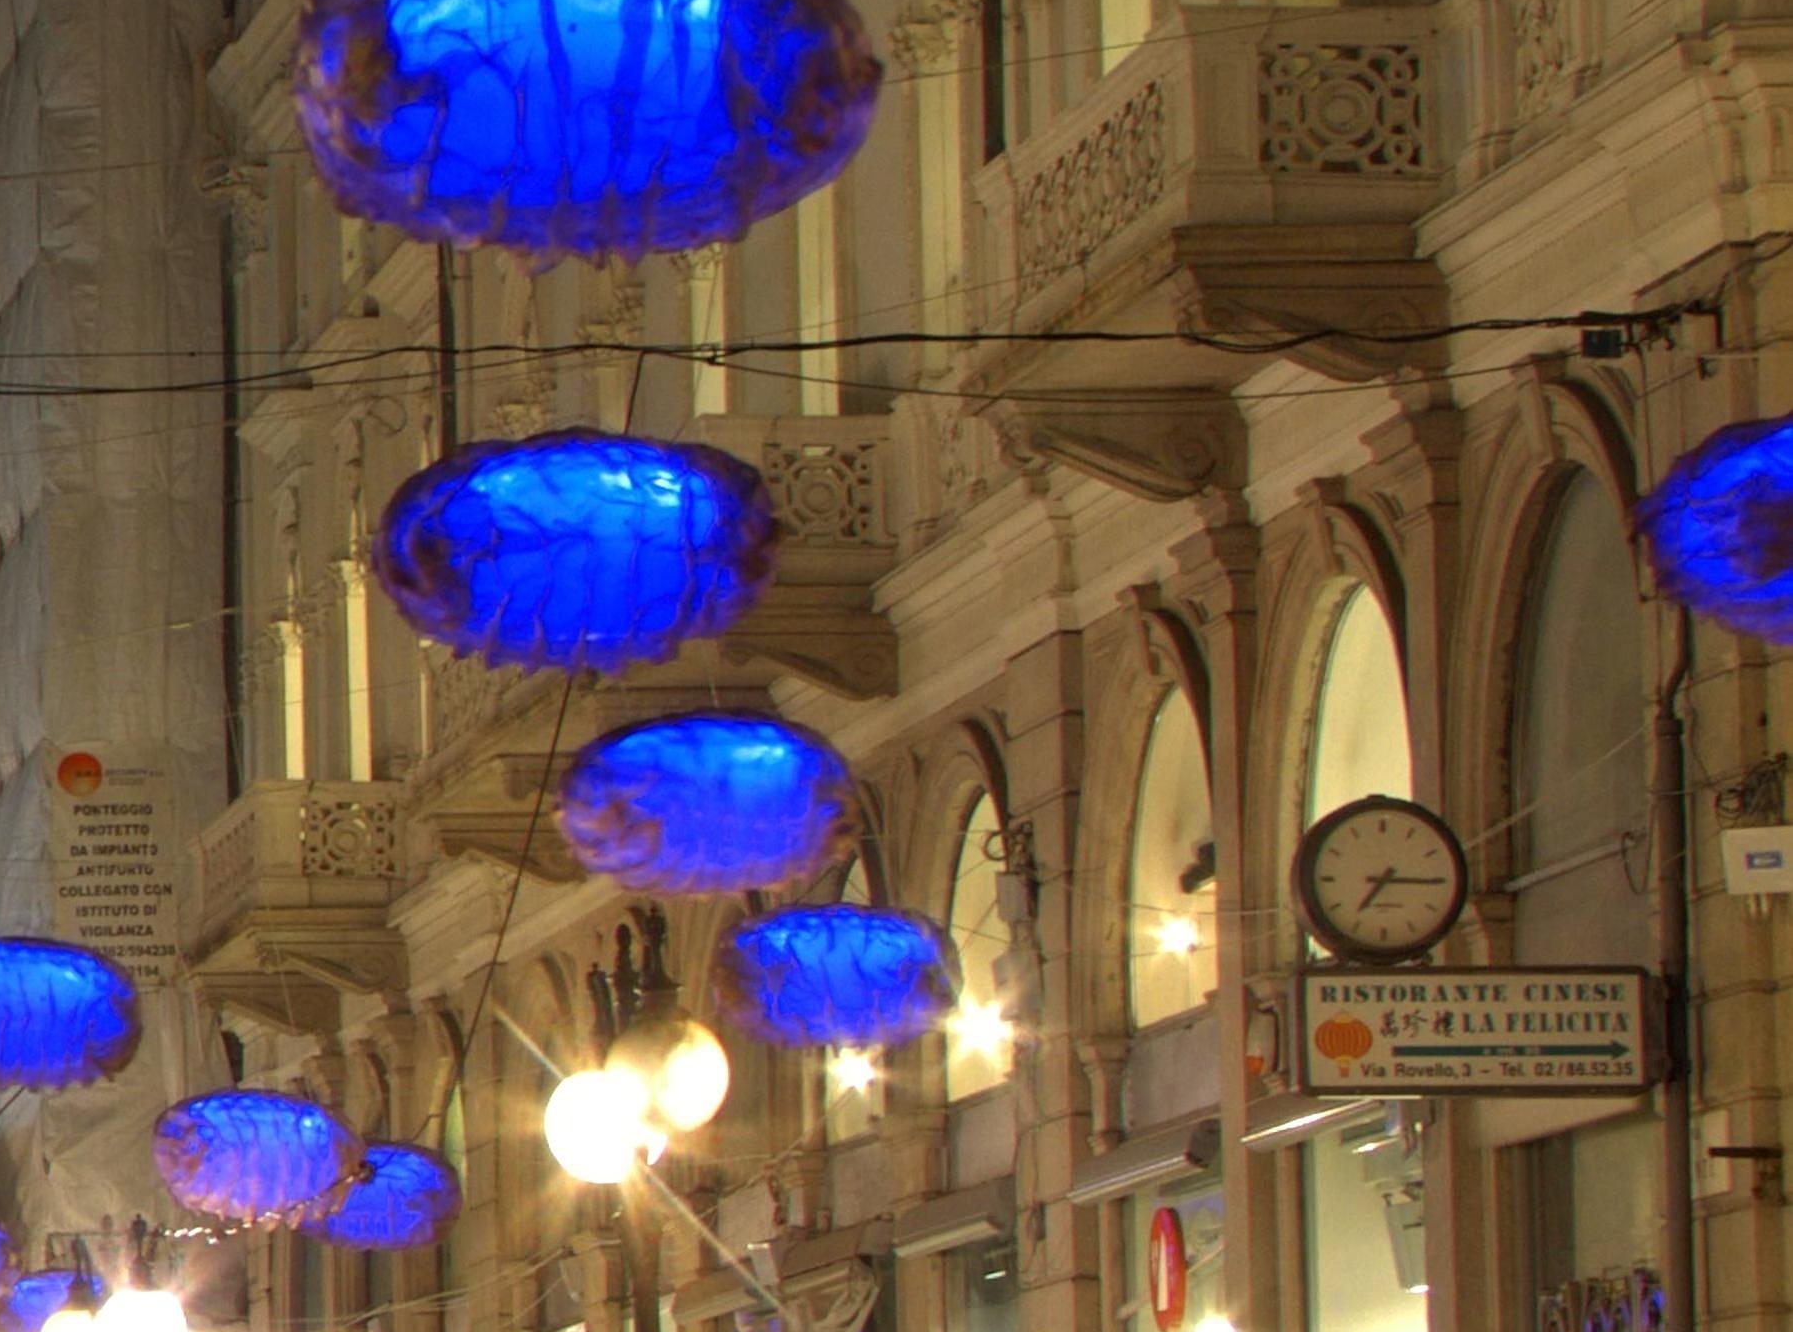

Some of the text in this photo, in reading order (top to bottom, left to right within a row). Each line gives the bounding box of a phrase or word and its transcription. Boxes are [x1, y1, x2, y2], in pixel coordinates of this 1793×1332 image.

[73, 804, 153, 816] PONTEGGIO
[78, 824, 150, 836] PROTETTO
[70, 843, 158, 856] DA IMPIANTO
[76, 864, 154, 876] ANTIFURTO
[58, 883, 172, 897] COLLEGATO CON
[75, 904, 157, 916] ISTITUTO DI
[79, 925, 154, 937] VIGILANZA
[1319, 982, 1625, 1004] RISTORANTE CINESE
[1462, 1013, 1495, 1034] LA
[1361, 1063, 1386, 1077] Via
[1499, 1062, 1525, 1076] Tel.
